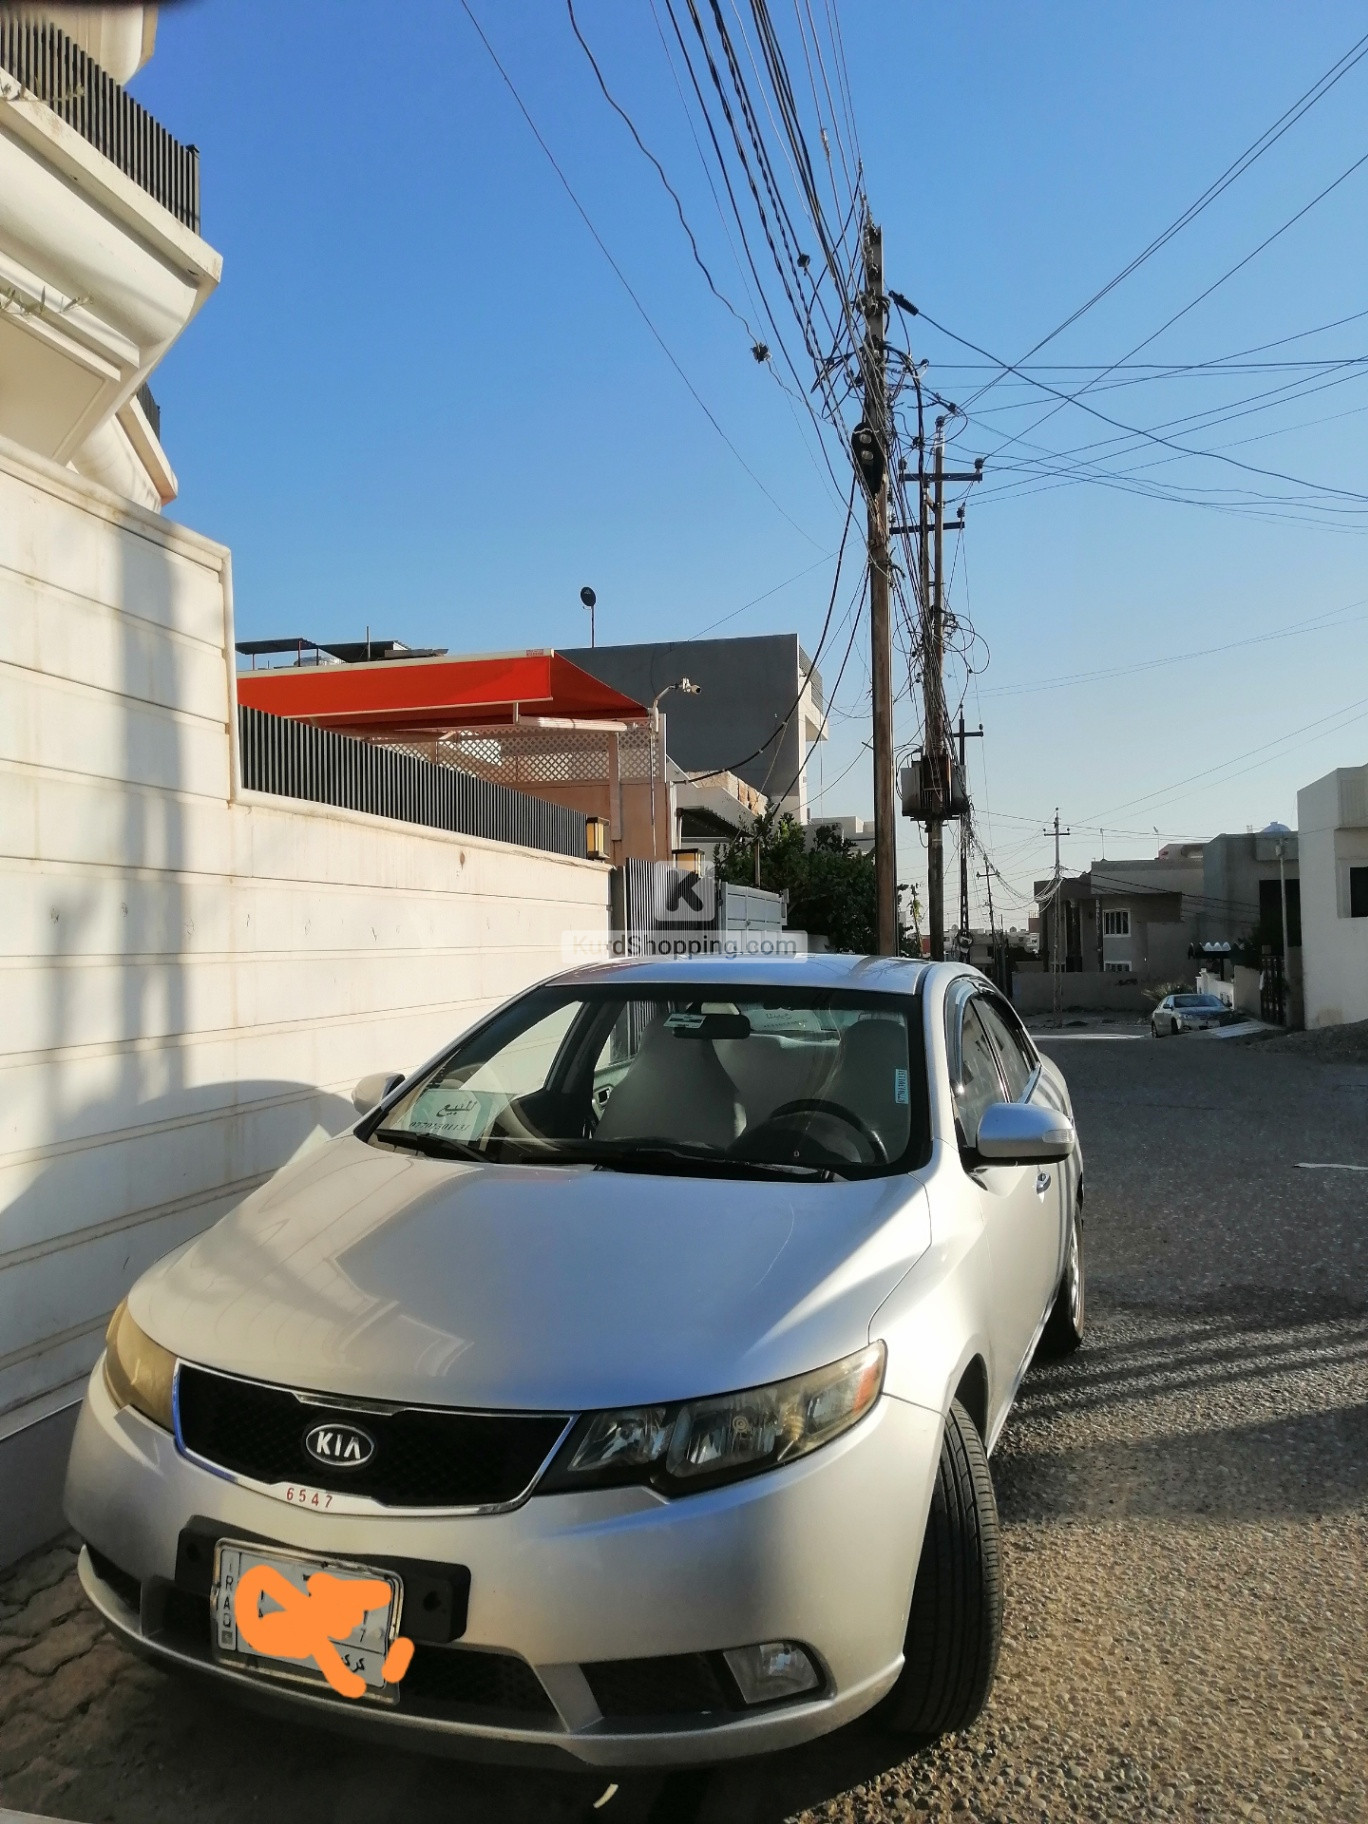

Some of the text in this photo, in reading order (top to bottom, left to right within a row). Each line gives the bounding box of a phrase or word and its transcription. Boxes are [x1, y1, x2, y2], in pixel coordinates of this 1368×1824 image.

[435, 1100, 478, 1117] للبيع
[316, 1430, 361, 1458] KIA
[286, 1487, 333, 1508] 6547
[223, 1563, 234, 1628] IRAQ
